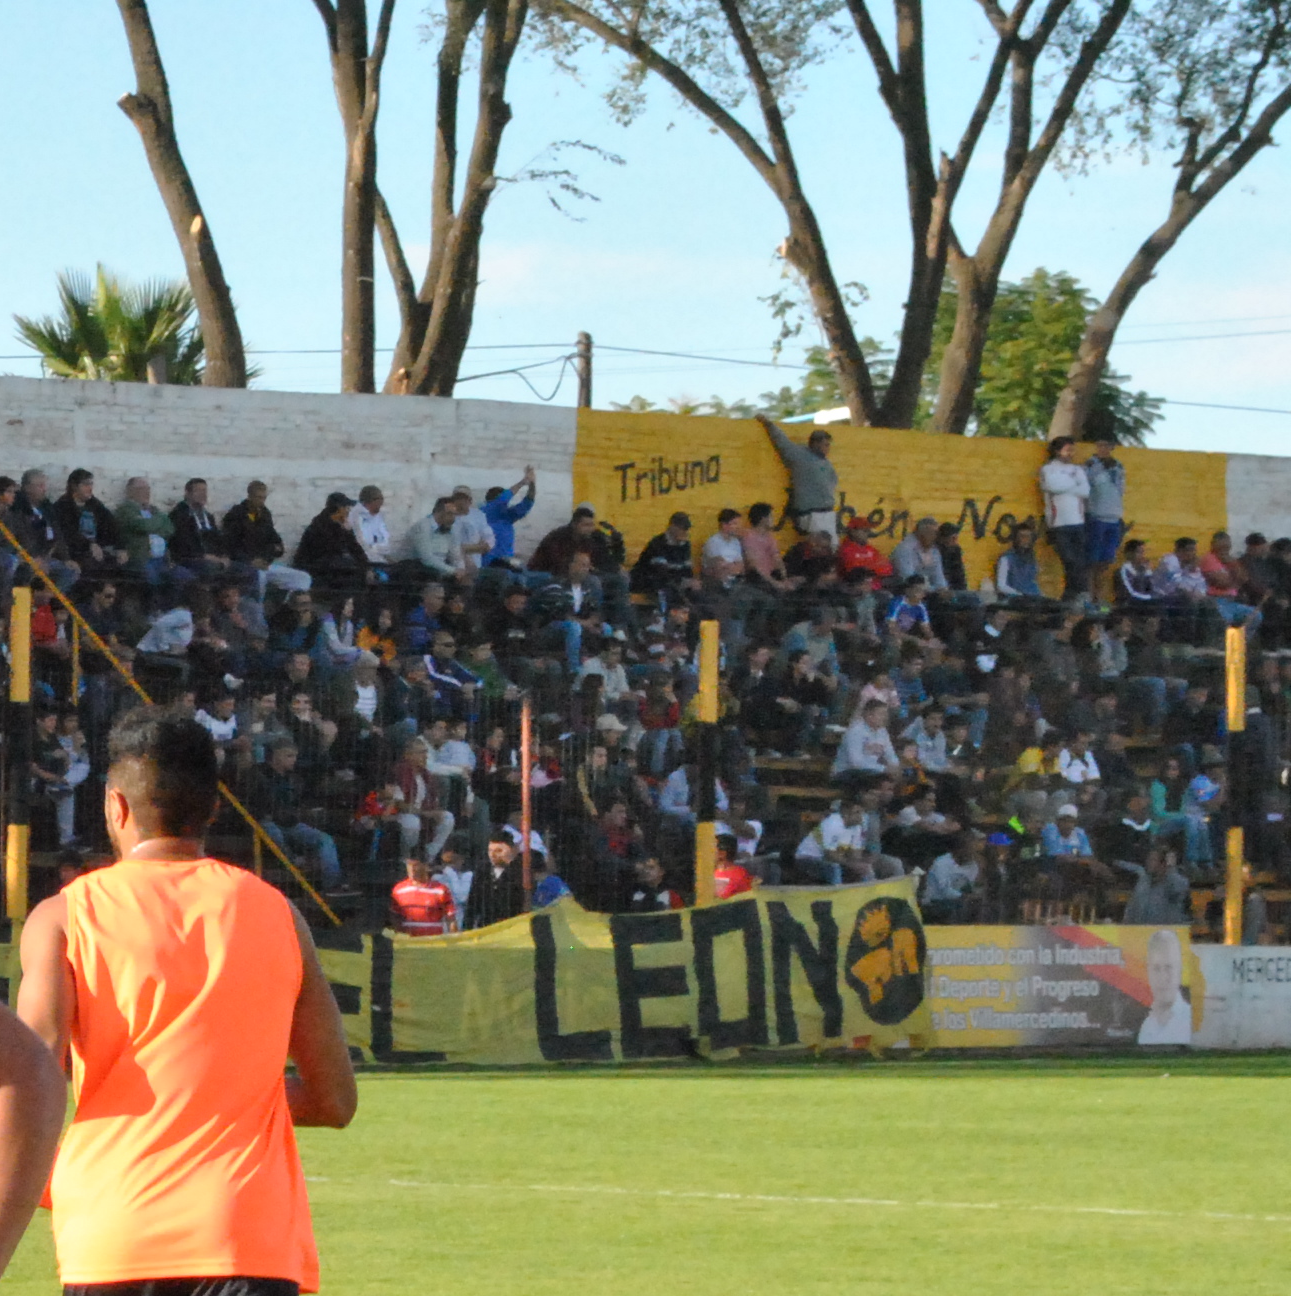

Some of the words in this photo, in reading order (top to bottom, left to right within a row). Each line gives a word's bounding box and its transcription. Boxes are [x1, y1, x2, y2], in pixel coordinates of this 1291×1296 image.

[613, 454, 722, 503] Tribuna
[1008, 949, 1034, 965] con
[1038, 945, 1053, 965] la
[530, 899, 844, 1061] LEON
[939, 976, 1001, 1001] Deporte
[1003, 980, 1013, 1002] y
[1016, 977, 1029, 997] el
[1032, 976, 1100, 1001] Progreso
[944, 1008, 966, 1029] los
